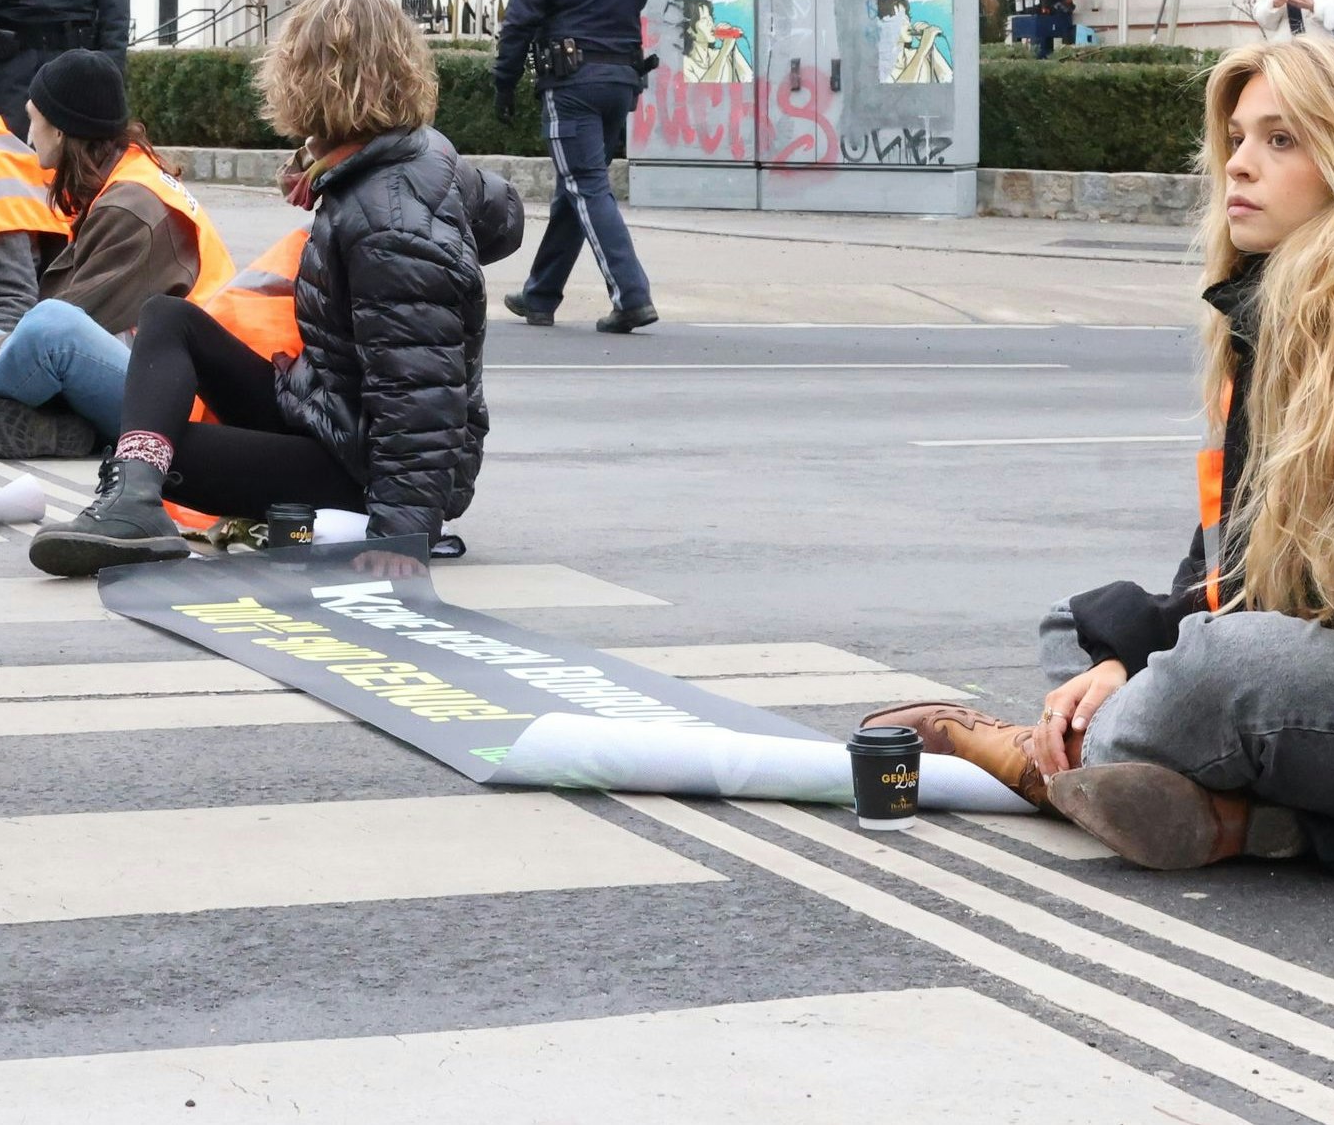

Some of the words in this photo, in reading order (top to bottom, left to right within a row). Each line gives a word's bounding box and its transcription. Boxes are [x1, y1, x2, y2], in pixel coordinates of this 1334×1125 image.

[251, 636, 388, 661] SIND
[326, 662, 536, 722] GENUG!
[311, 580, 454, 629] KEINE
[396, 630, 565, 665] NEUEN
[504, 665, 719, 723] BOHRUN
